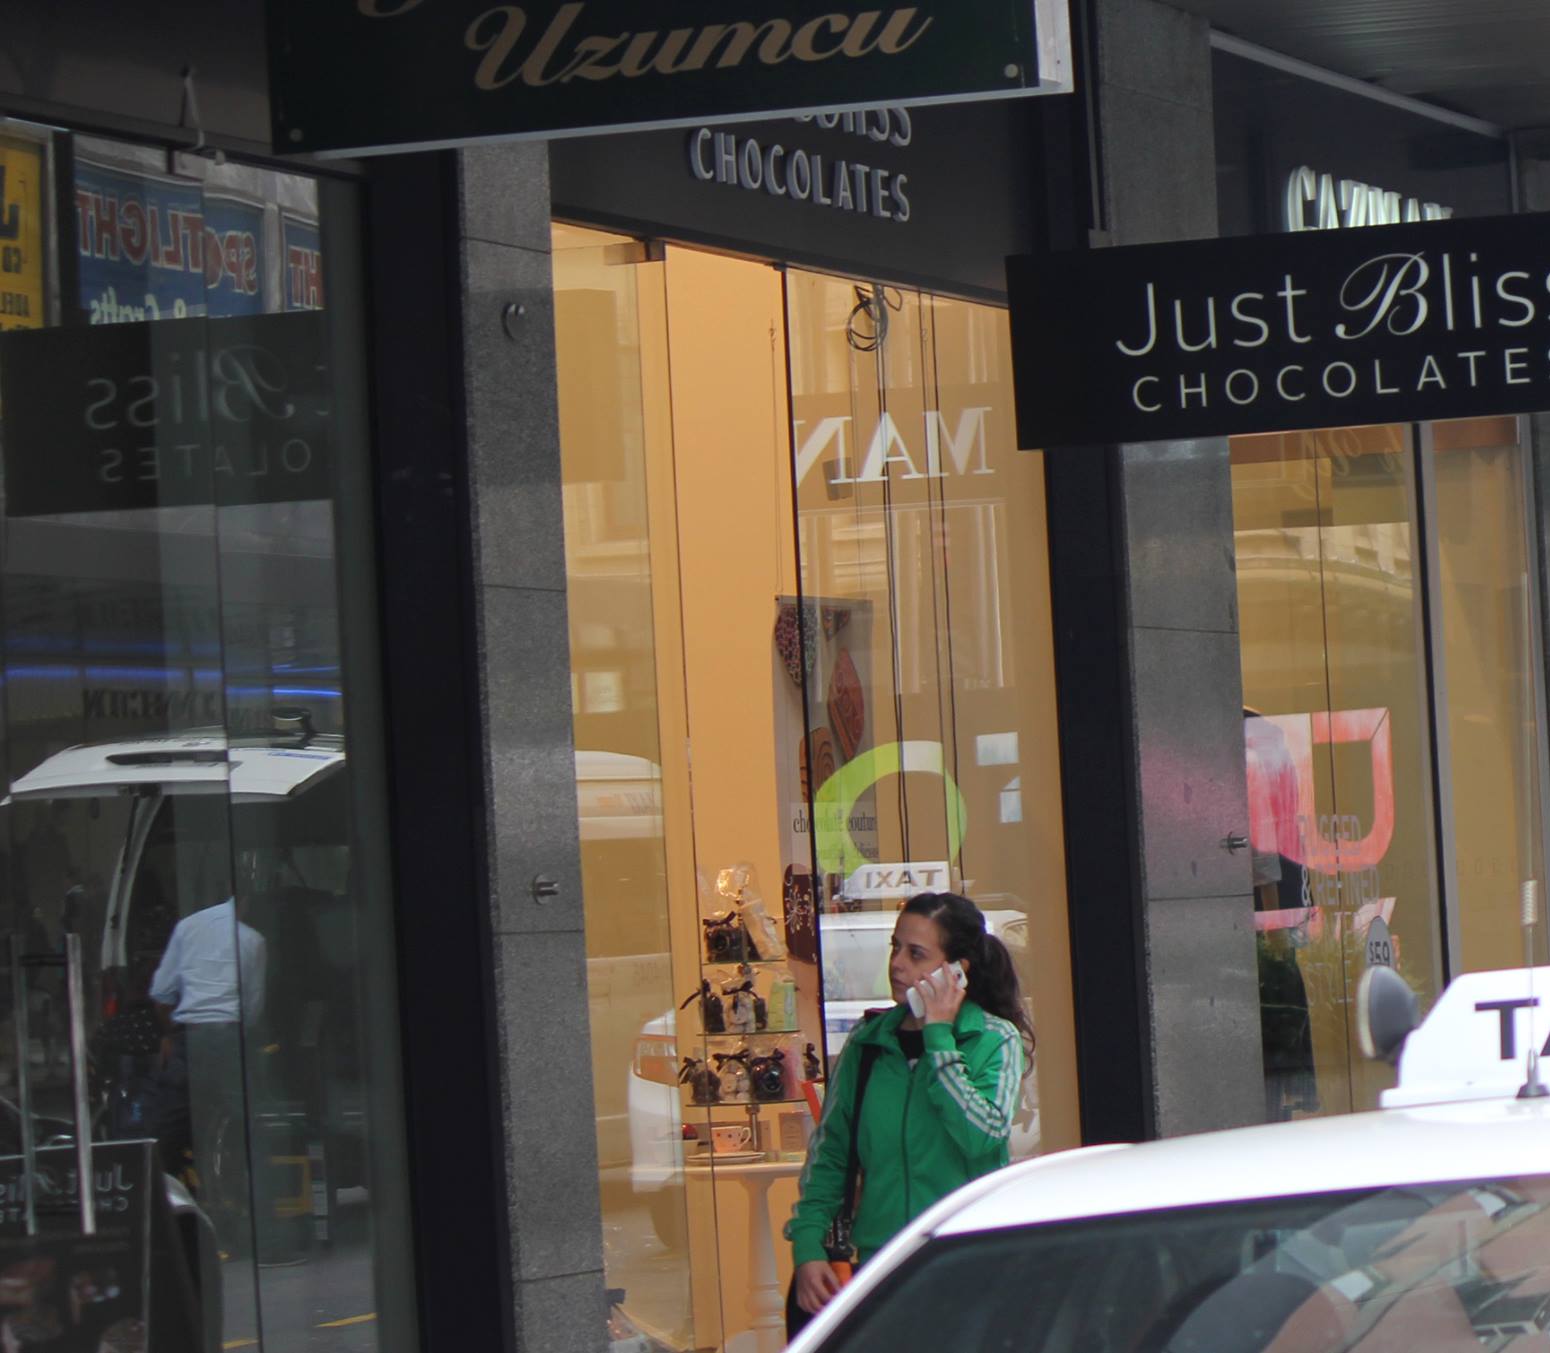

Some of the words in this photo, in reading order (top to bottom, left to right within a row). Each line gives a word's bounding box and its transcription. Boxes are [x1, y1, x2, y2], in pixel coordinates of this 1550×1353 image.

[464, 2, 932, 91] Uzumcu
[689, 128, 912, 222] CHOCOLATES
[1285, 165, 1453, 232] GAZM
[1116, 272, 1312, 356] Just
